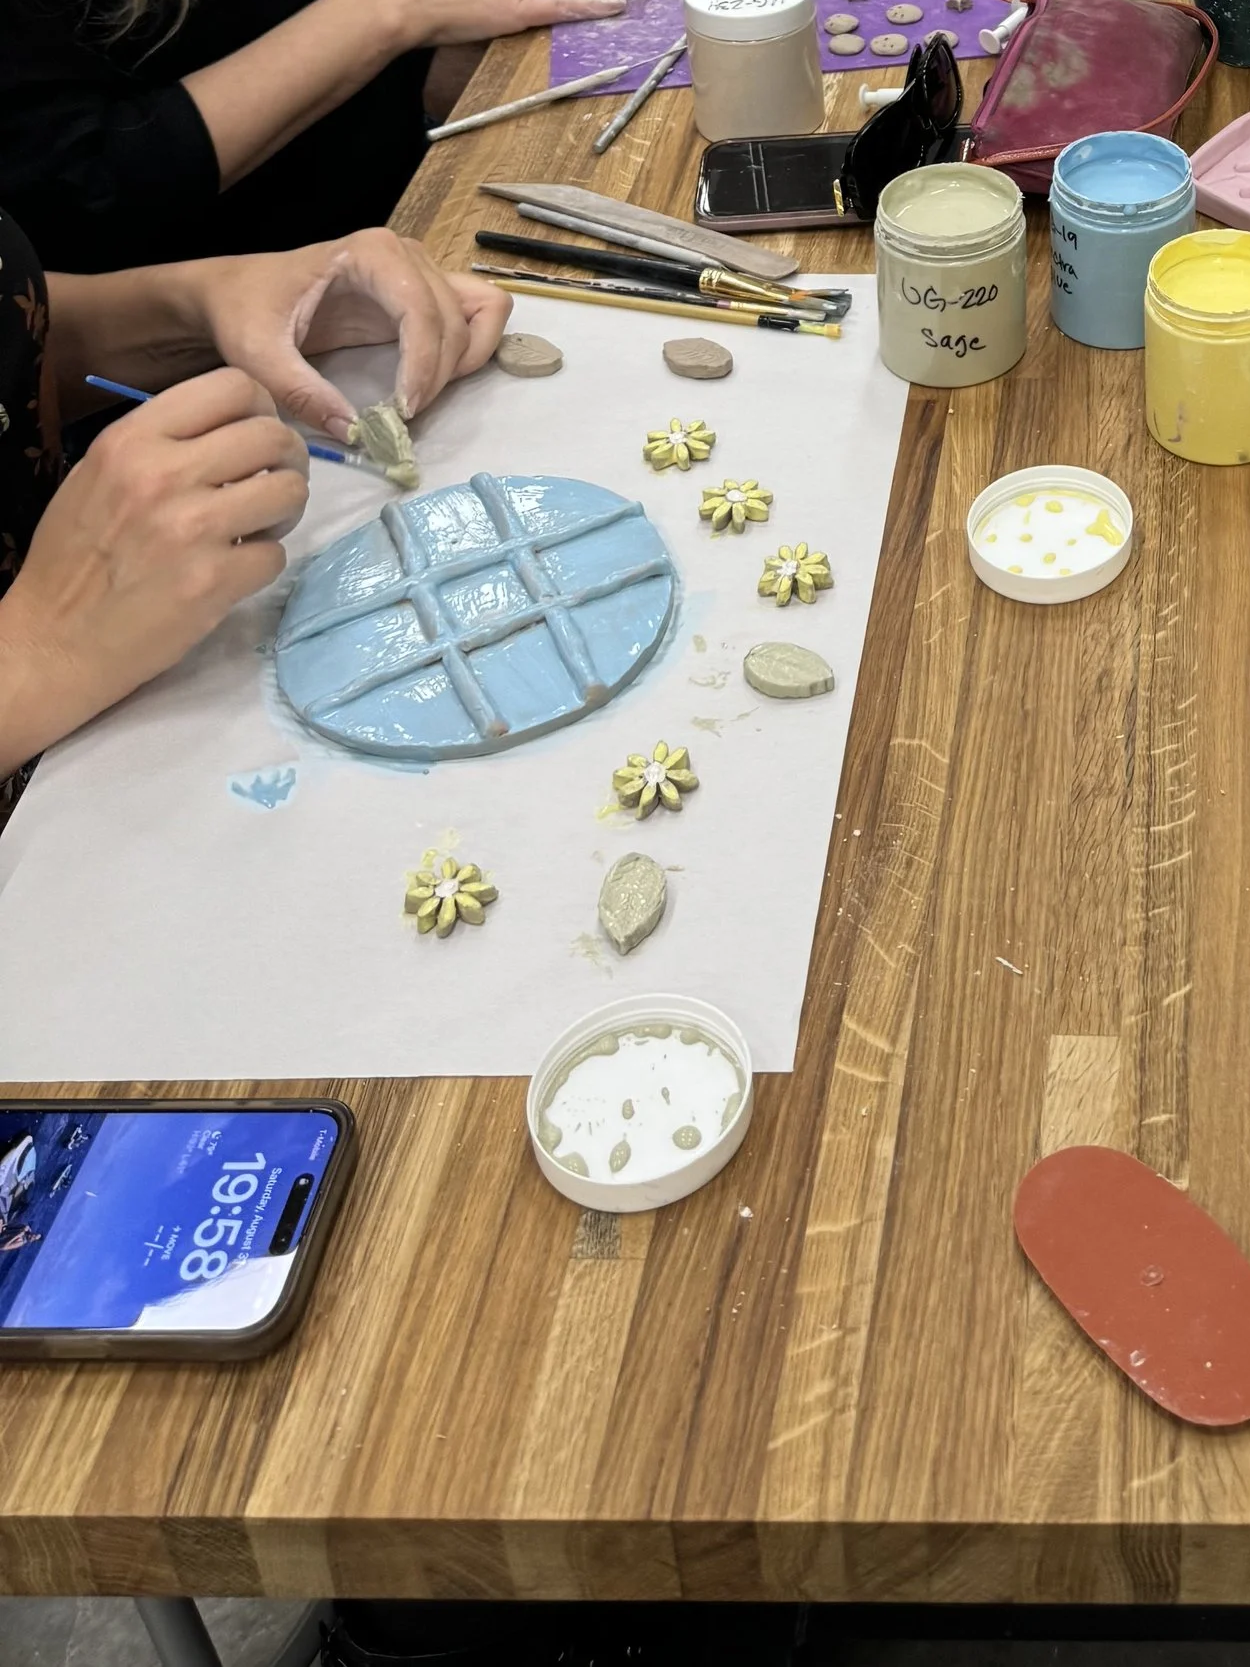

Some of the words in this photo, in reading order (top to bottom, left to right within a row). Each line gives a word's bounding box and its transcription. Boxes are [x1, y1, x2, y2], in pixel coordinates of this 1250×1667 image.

[901, 277, 999, 312] UG-220
[921, 327, 987, 358] Sage
[308, 1129, 327, 1161] T-Mobile
[254, 1167, 283, 1213] Saturday,
[179, 1152, 267, 1281] 19:58
[241, 1214, 264, 1251] August
[161, 1230, 179, 1261] MOVE
